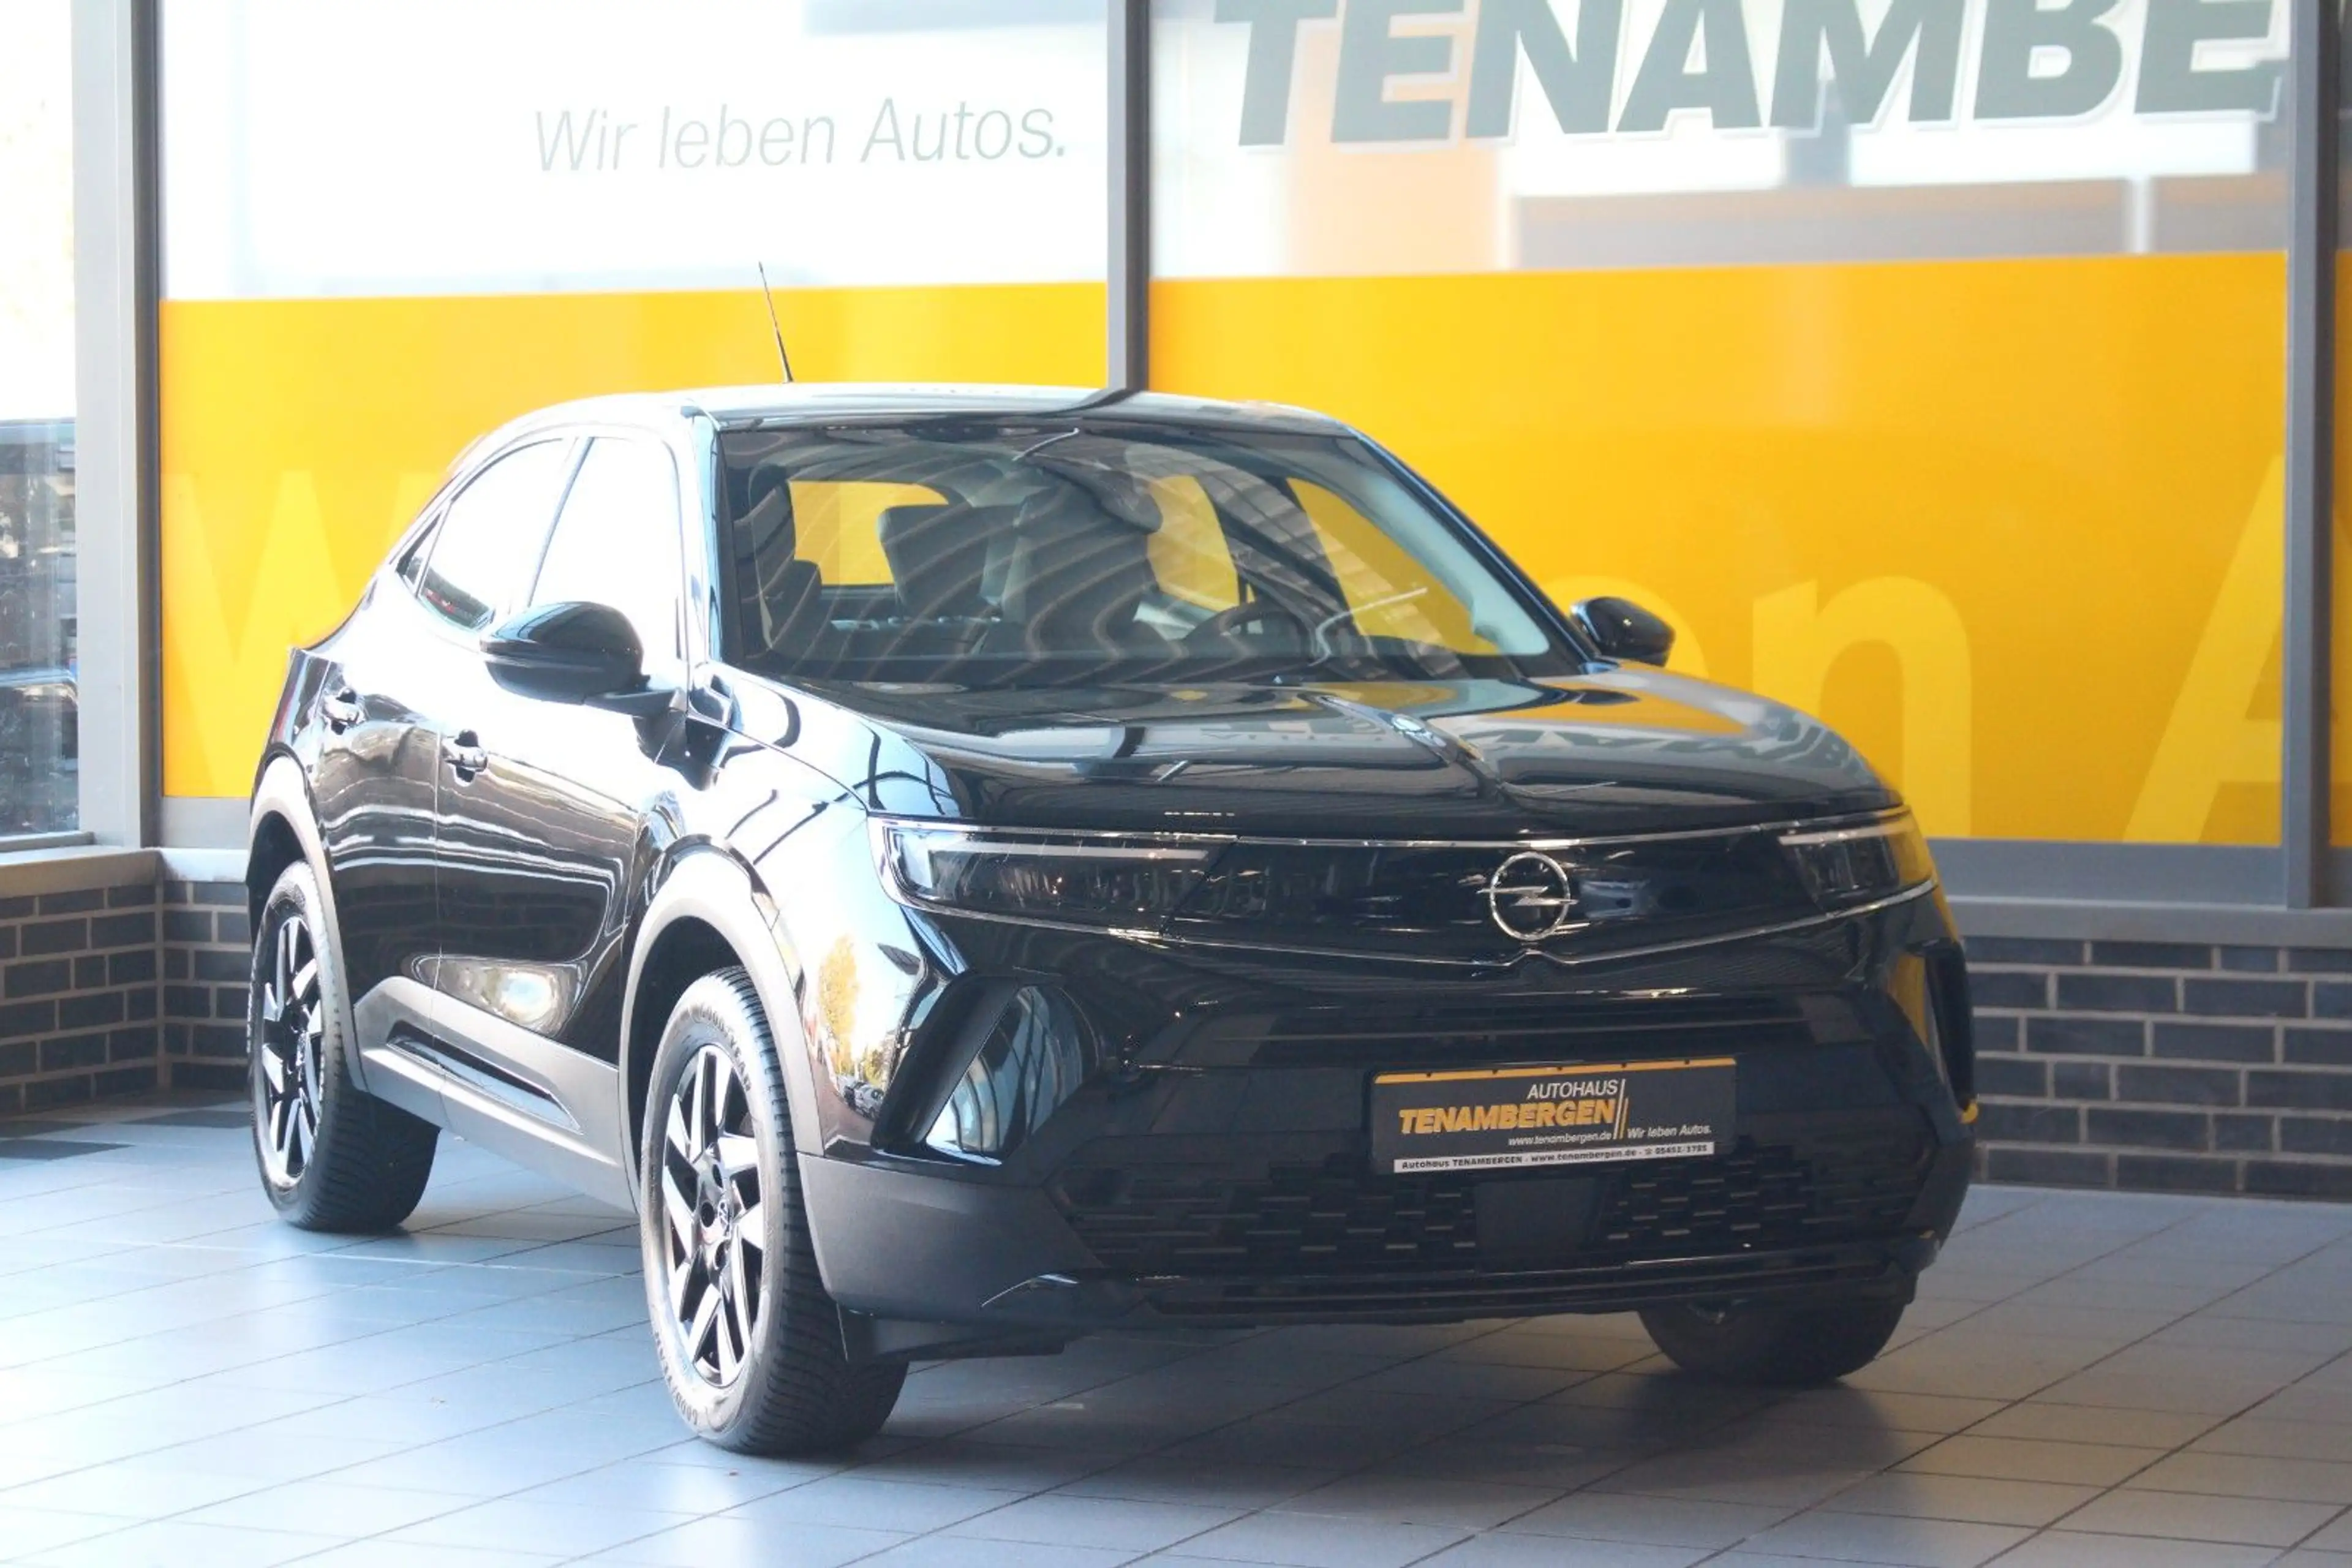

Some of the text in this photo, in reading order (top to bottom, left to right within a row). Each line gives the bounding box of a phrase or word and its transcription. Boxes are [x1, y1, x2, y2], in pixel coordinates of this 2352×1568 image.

[1216, 0, 2290, 149] TENAMBE
[535, 97, 1065, 172] Wir leben Autos.
[1527, 1079, 1619, 1100] AUTOHAUS
[1399, 1099, 1617, 1134] TENAMBERGEN
[1508, 1131, 1612, 1146] www.tenambergen.de
[1627, 1123, 1712, 1139] Wir leben Autos.
[1401, 1159, 1450, 1170] Autohaus
[1452, 1155, 1523, 1168] TENAMBERGEN
[1531, 1149, 1637, 1163] www.tenambergen.de
